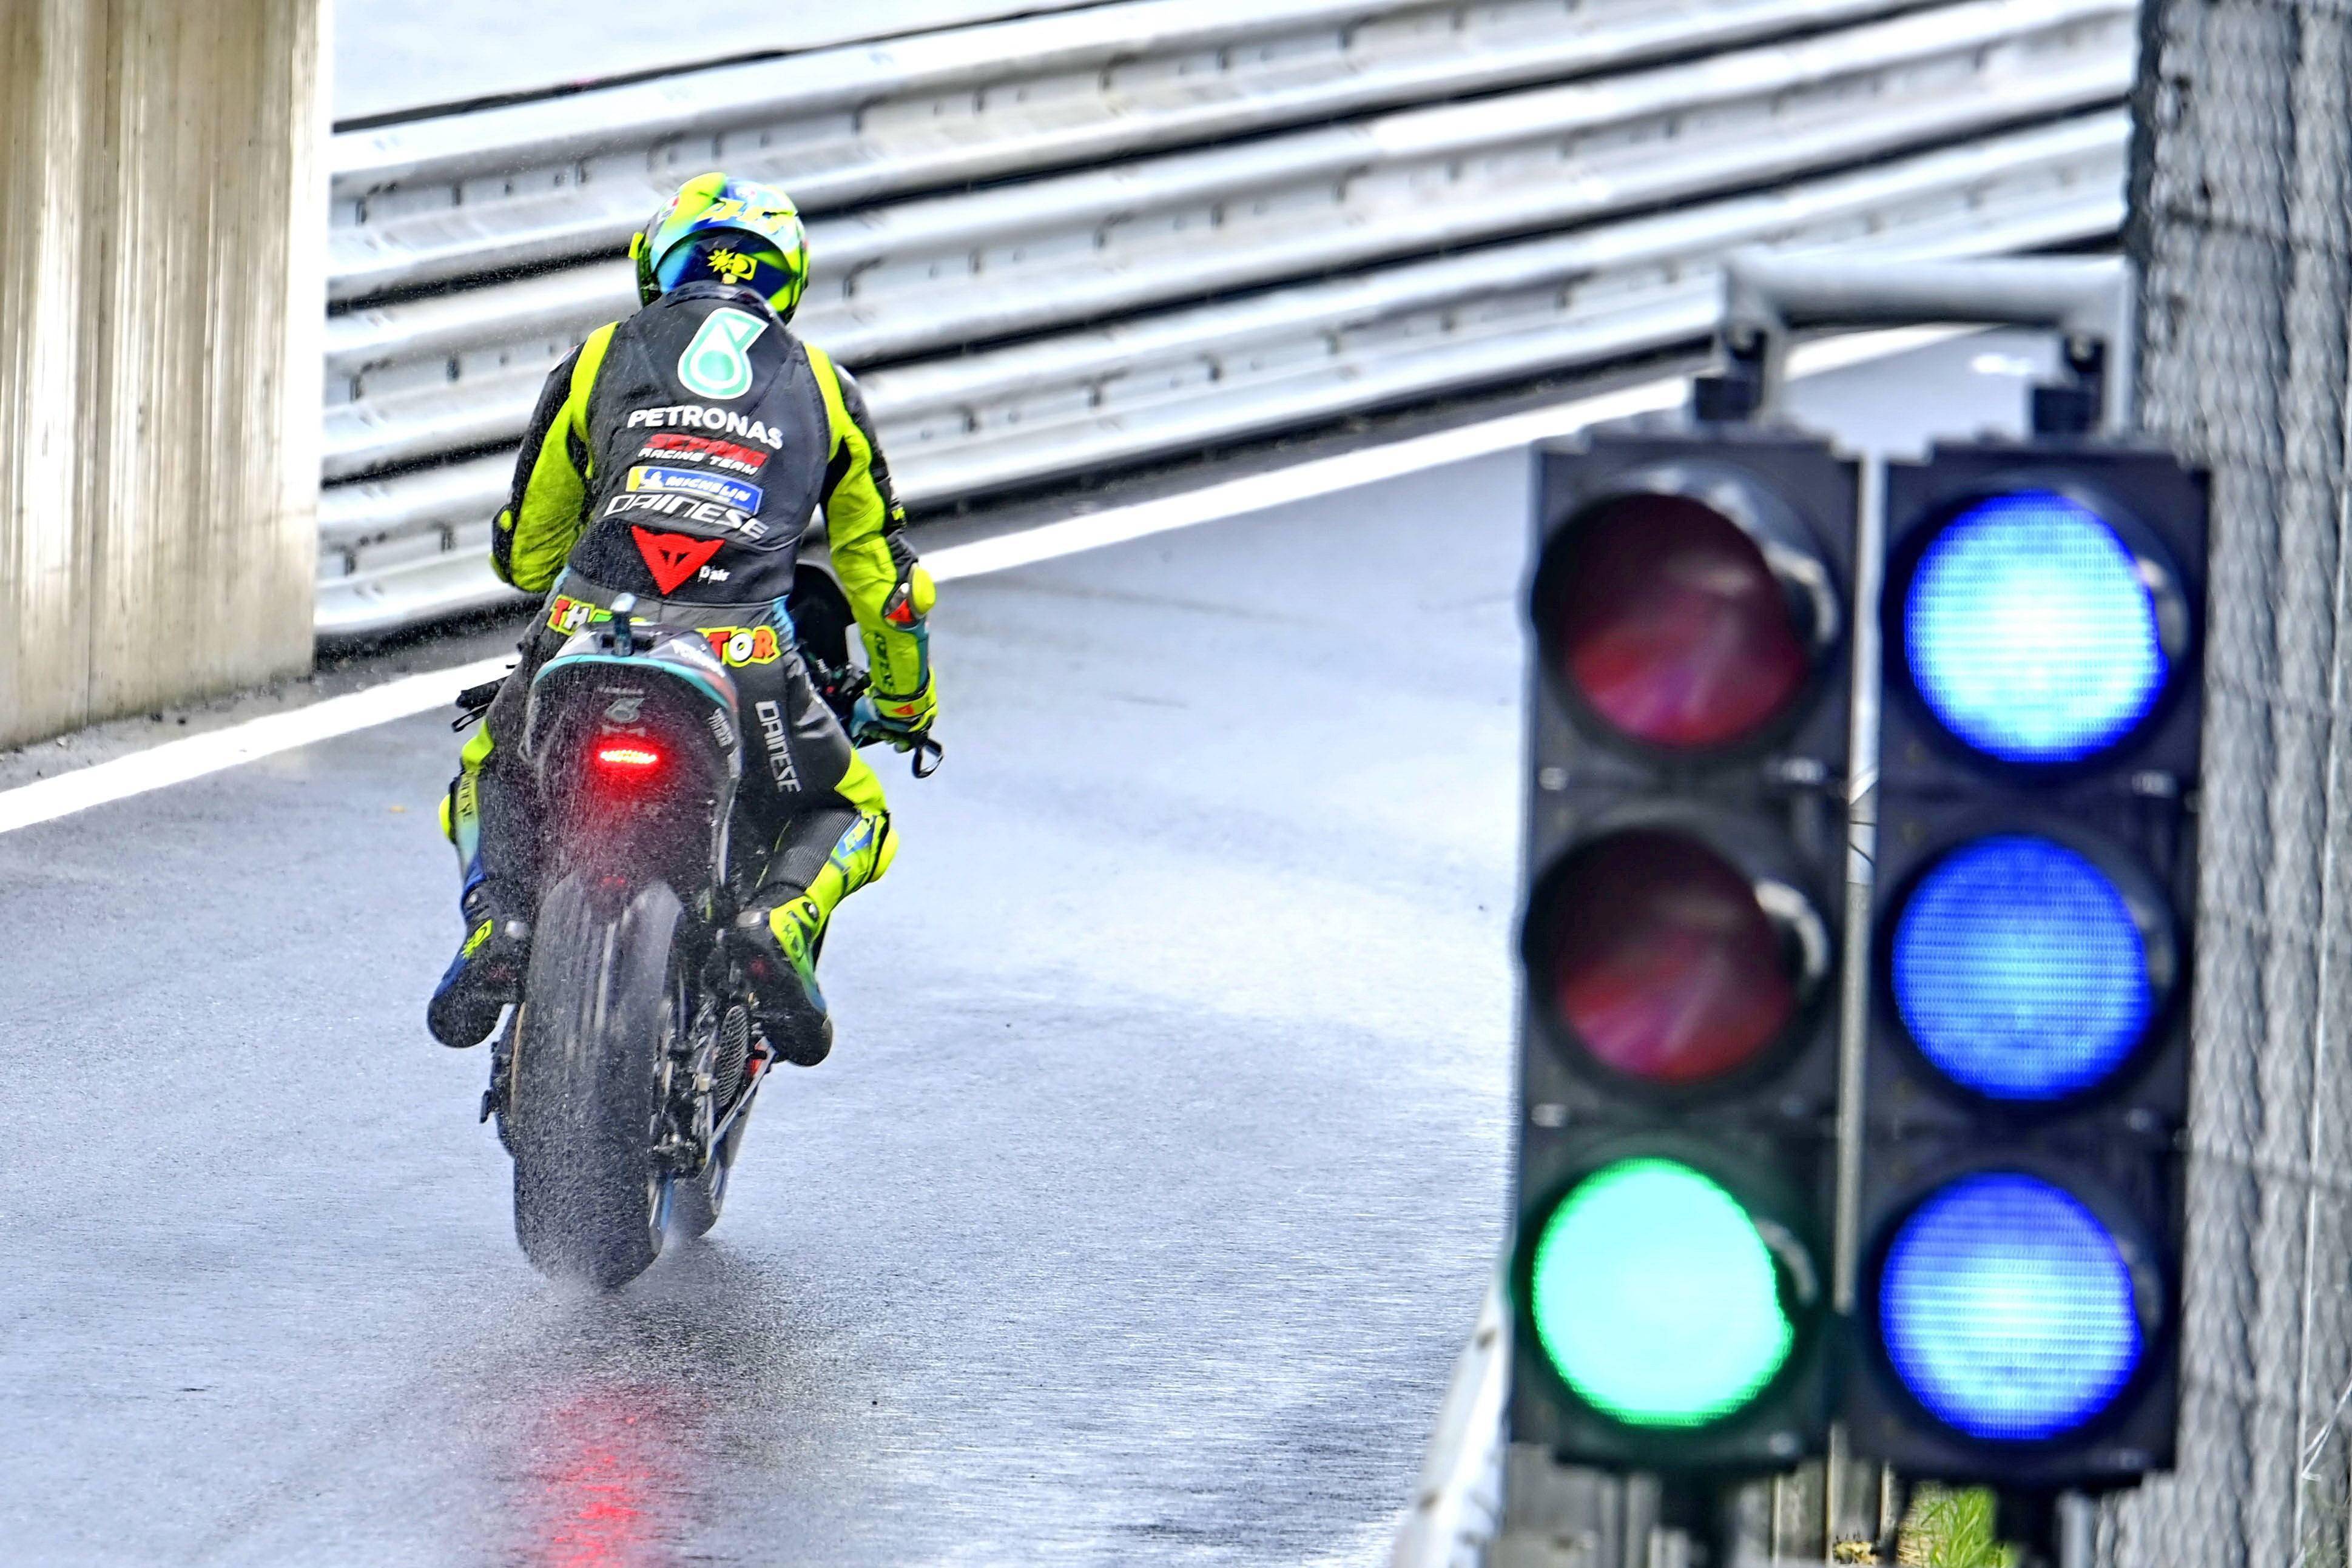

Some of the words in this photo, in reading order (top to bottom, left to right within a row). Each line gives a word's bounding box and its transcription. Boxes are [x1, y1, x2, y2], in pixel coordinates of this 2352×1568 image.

[627, 405, 783, 450] PETRONAS
[638, 447, 706, 462] RACING
[709, 455, 760, 476] TEAM
[664, 476, 752, 502] MICHELIN
[603, 493, 769, 539] DAINESE
[703, 627, 778, 664] TOR
[755, 700, 802, 792] DAINESE
